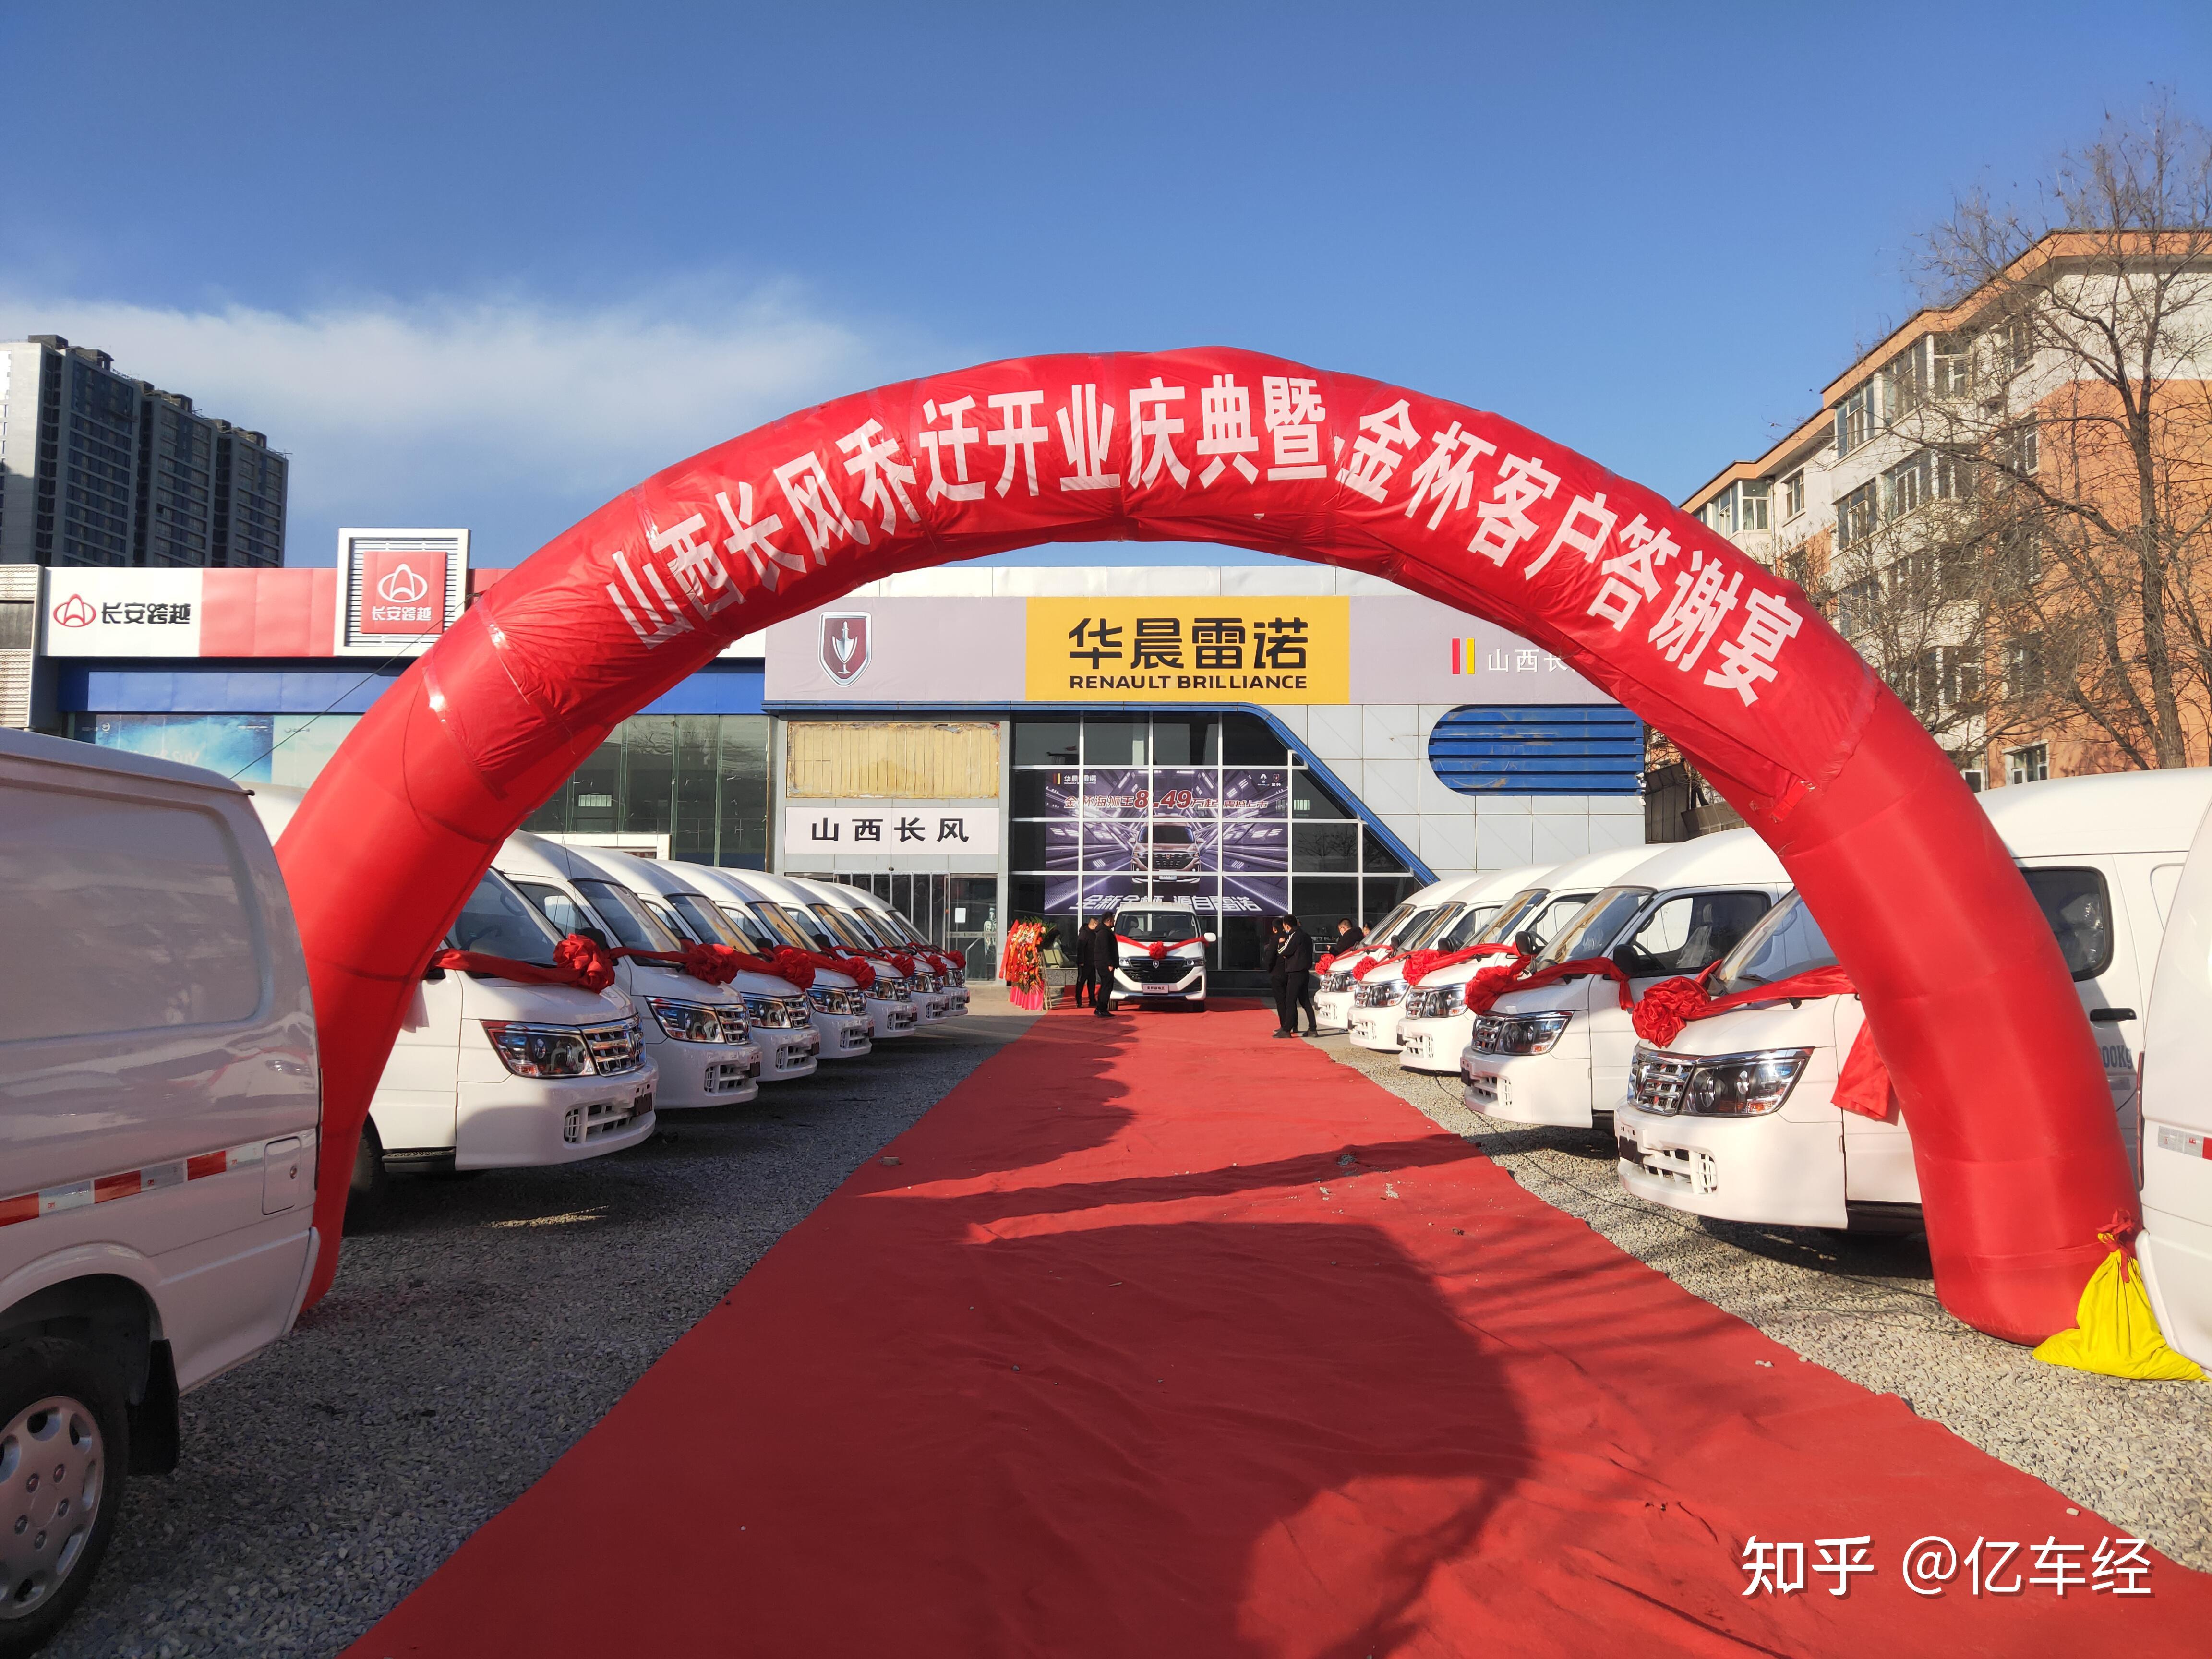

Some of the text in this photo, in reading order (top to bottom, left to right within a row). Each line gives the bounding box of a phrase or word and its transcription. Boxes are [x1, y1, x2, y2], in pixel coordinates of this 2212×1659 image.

[101, 602, 191, 625] 长安跨越
[372, 606, 432, 622] 长安跨越
[1069, 617, 1309, 670] 华晨雷诺
[1488, 648, 1576, 673] 山西长
[1070, 675, 1307, 689] RENAULT BRILLIANCE
[811, 817, 970, 843] 山西长风
